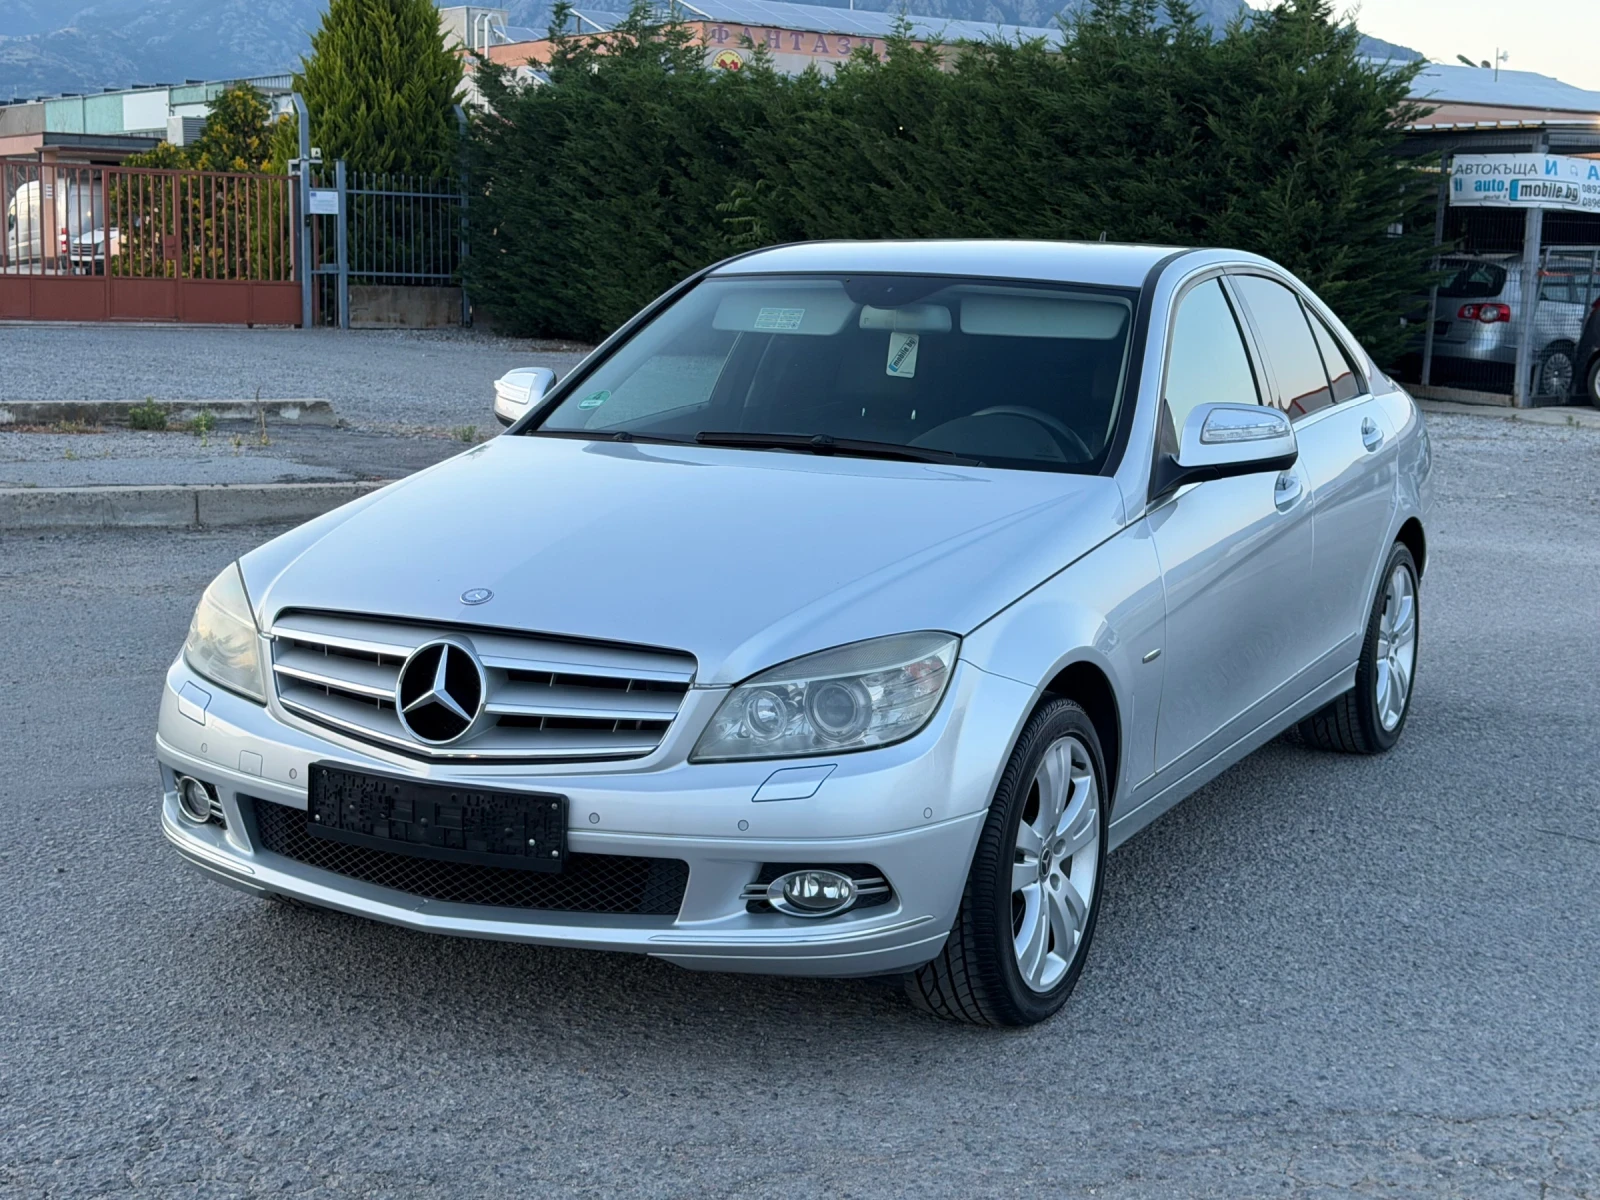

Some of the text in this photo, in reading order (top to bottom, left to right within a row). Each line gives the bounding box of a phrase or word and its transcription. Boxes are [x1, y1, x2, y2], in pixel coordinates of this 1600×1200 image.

[712, 25, 888, 58] ФАНТАЗ
[1455, 163, 1538, 176] АВТОКЪЩА
[1520, 182, 1578, 201] mobile.bg
